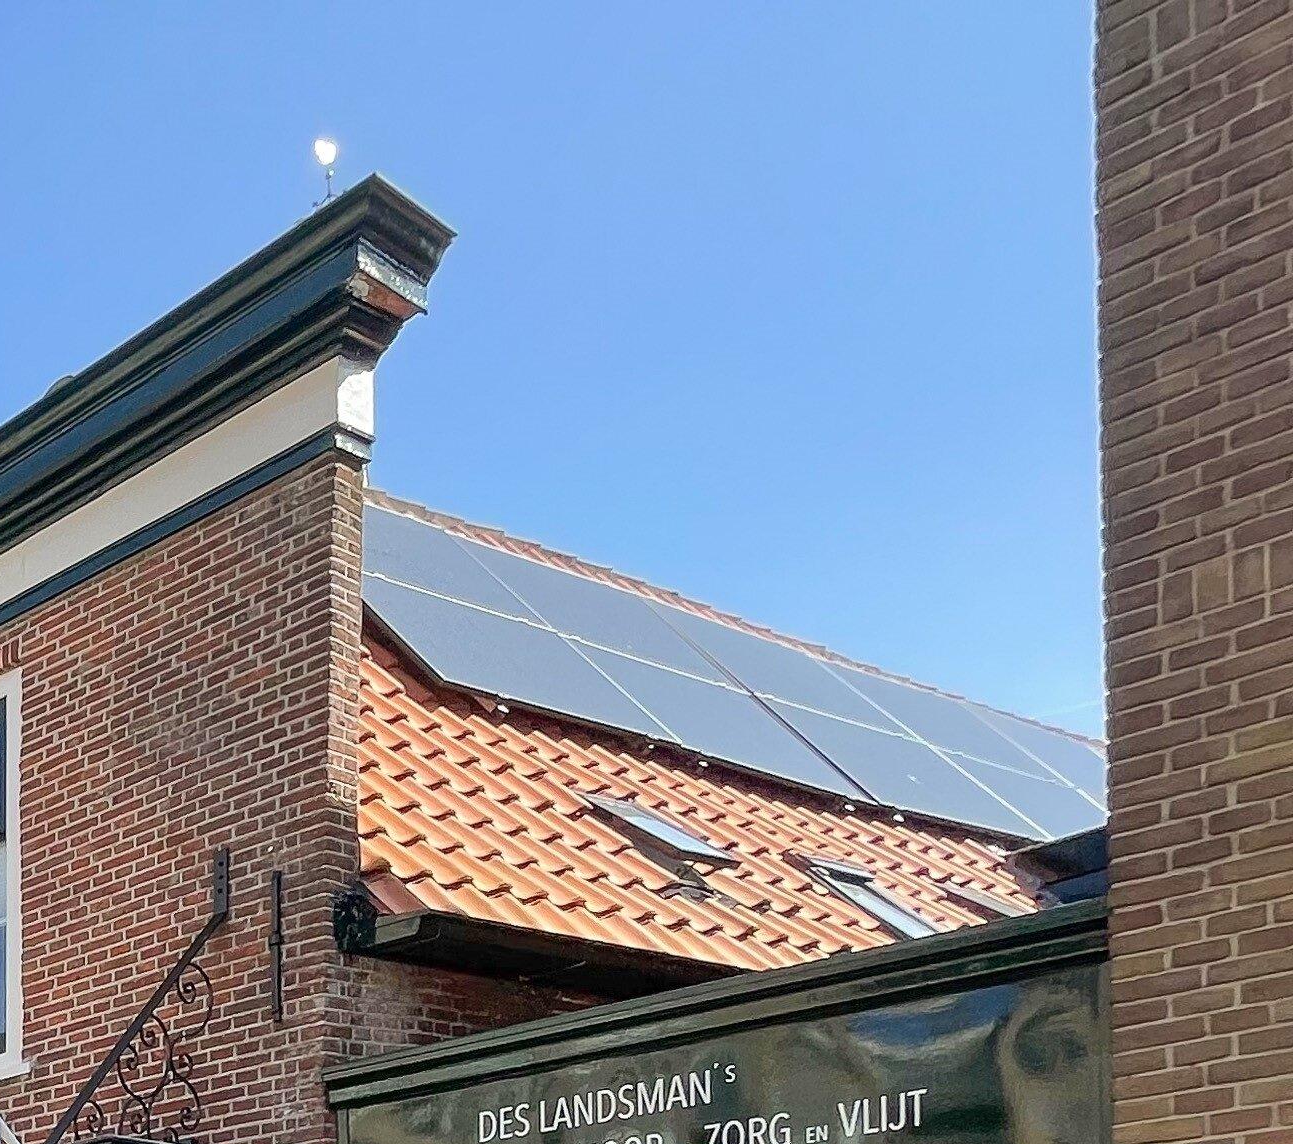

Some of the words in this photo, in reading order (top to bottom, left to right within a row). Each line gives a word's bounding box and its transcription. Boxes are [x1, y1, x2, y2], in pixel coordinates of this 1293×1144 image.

[477, 1102, 531, 1144] DES
[805, 1124, 829, 1144] EN
[837, 1088, 928, 1140] VLIJT
